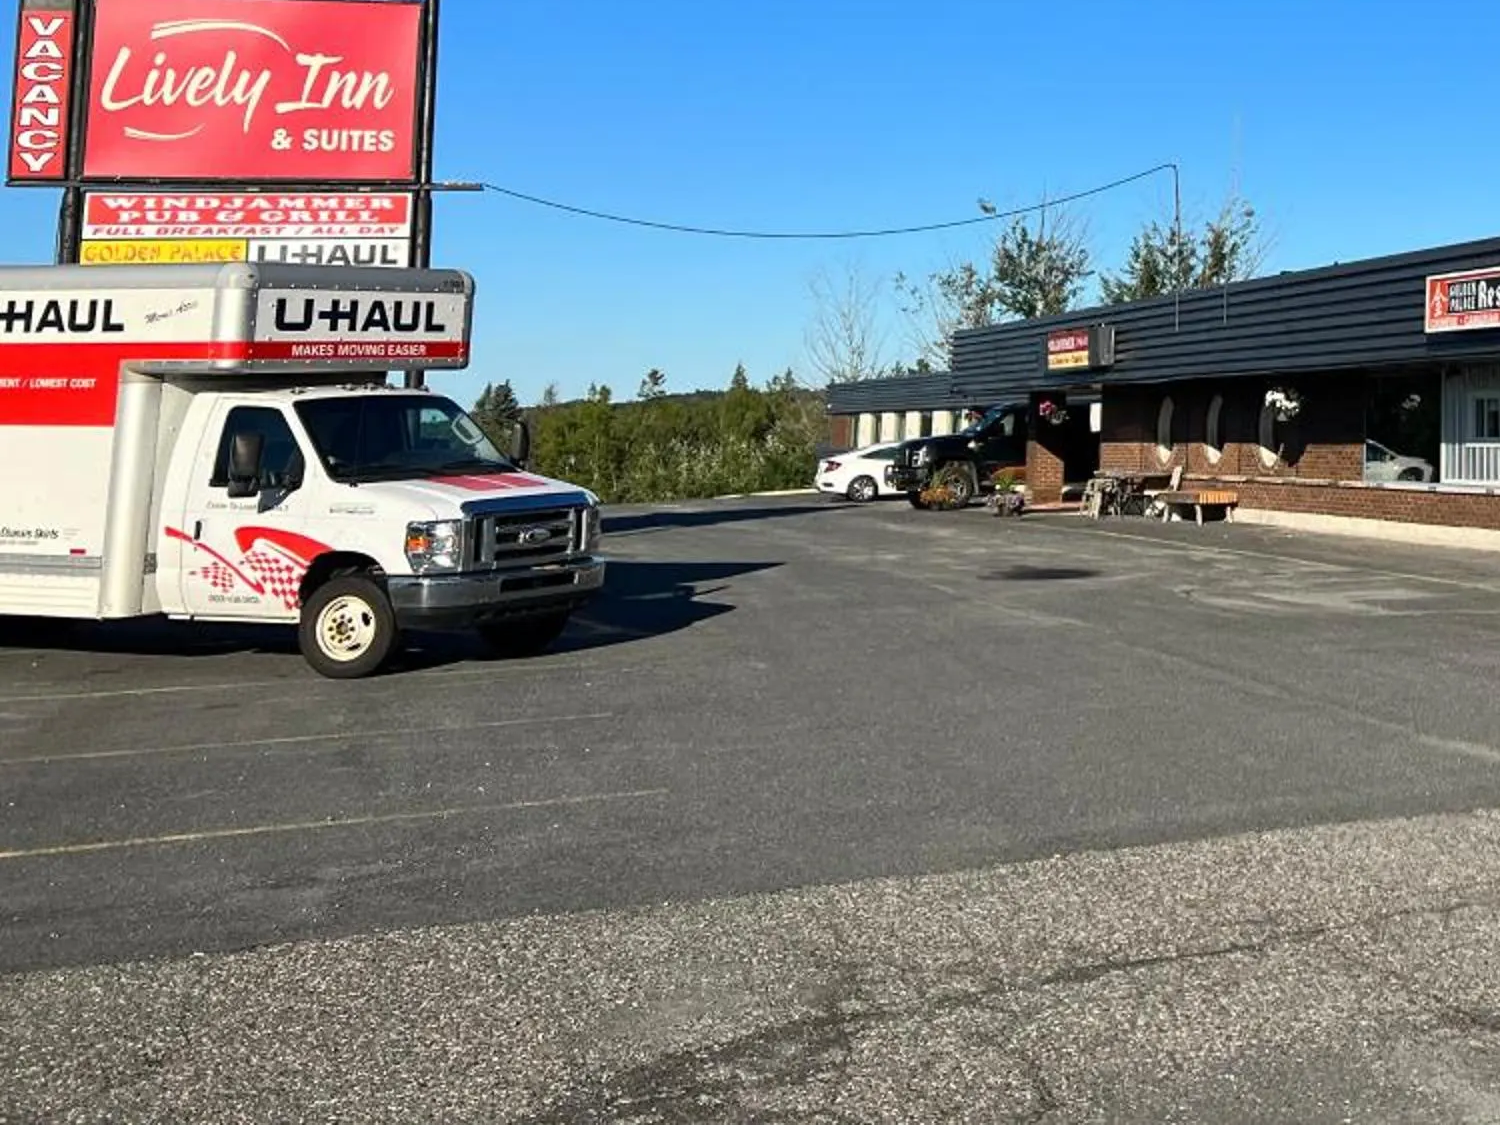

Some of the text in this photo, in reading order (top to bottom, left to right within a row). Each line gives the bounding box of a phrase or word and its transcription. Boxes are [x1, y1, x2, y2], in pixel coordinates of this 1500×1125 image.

[17, 17, 65, 172] VACANCY
[101, 47, 394, 133] Lively Inn
[271, 128, 395, 152] & SUITES
[101, 196, 395, 210] WINDJAMMER
[116, 210, 380, 223] PUB & GRILL
[91, 226, 157, 236] FULL
[163, 226, 286, 236] BREAKFAST
[311, 226, 348, 236] ALL
[360, 226, 401, 236] DAY
[83, 244, 242, 263] GOLDEN PALACE
[275, 298, 445, 333] U-HAUL
[291, 344, 427, 356] MAKES MOVING EASIER
